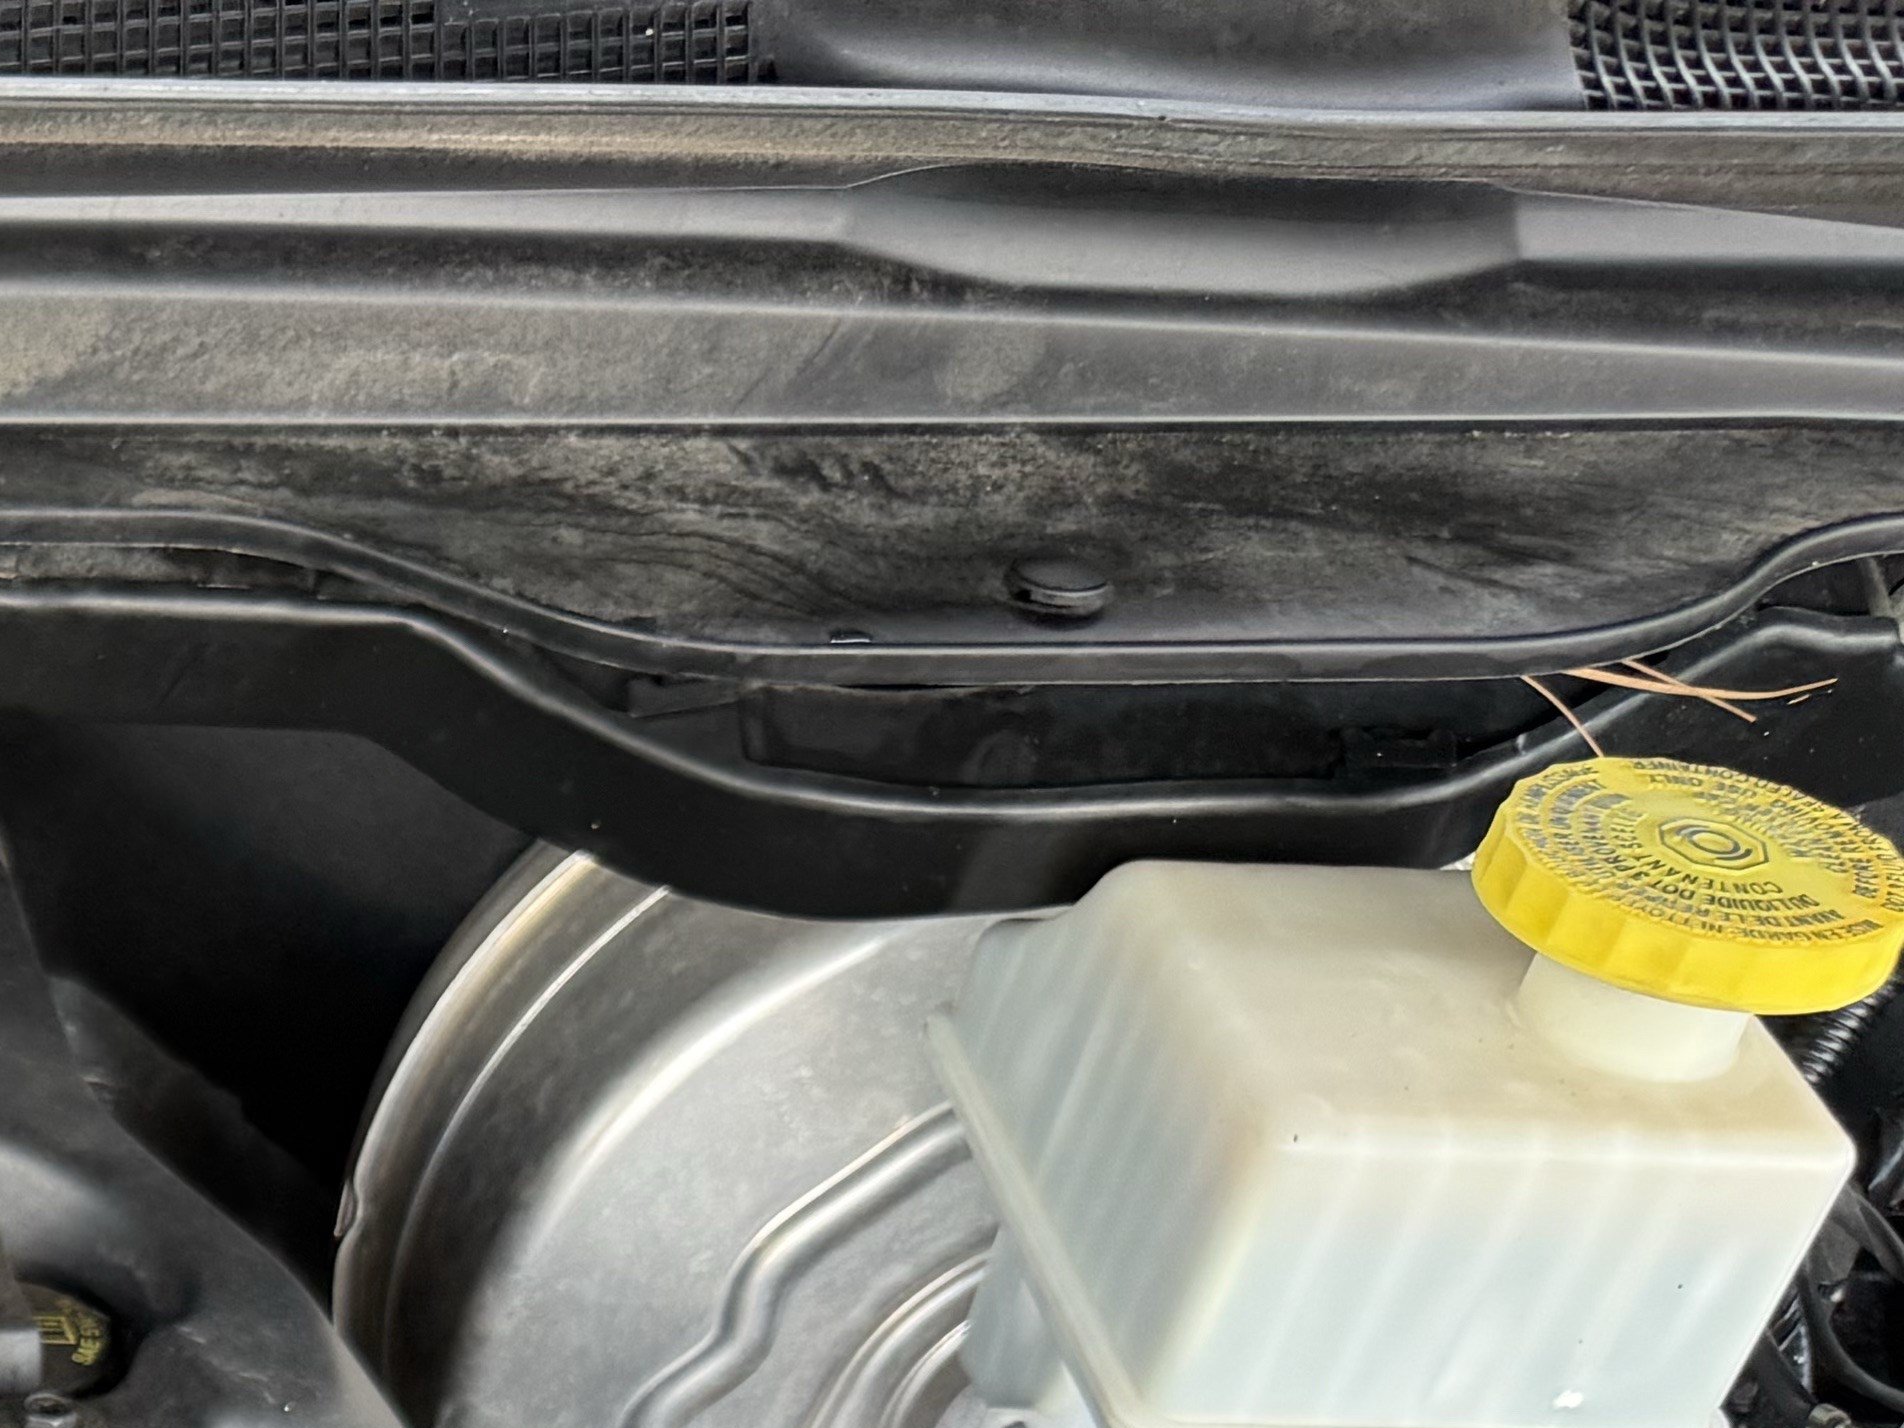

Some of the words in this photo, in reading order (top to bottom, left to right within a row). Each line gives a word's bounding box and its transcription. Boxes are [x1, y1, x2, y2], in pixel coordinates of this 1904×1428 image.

[1630, 854, 1782, 894] CONTENANT
[1648, 879, 1694, 900] DOT
[1704, 893, 1792, 911] LIQUIDE
